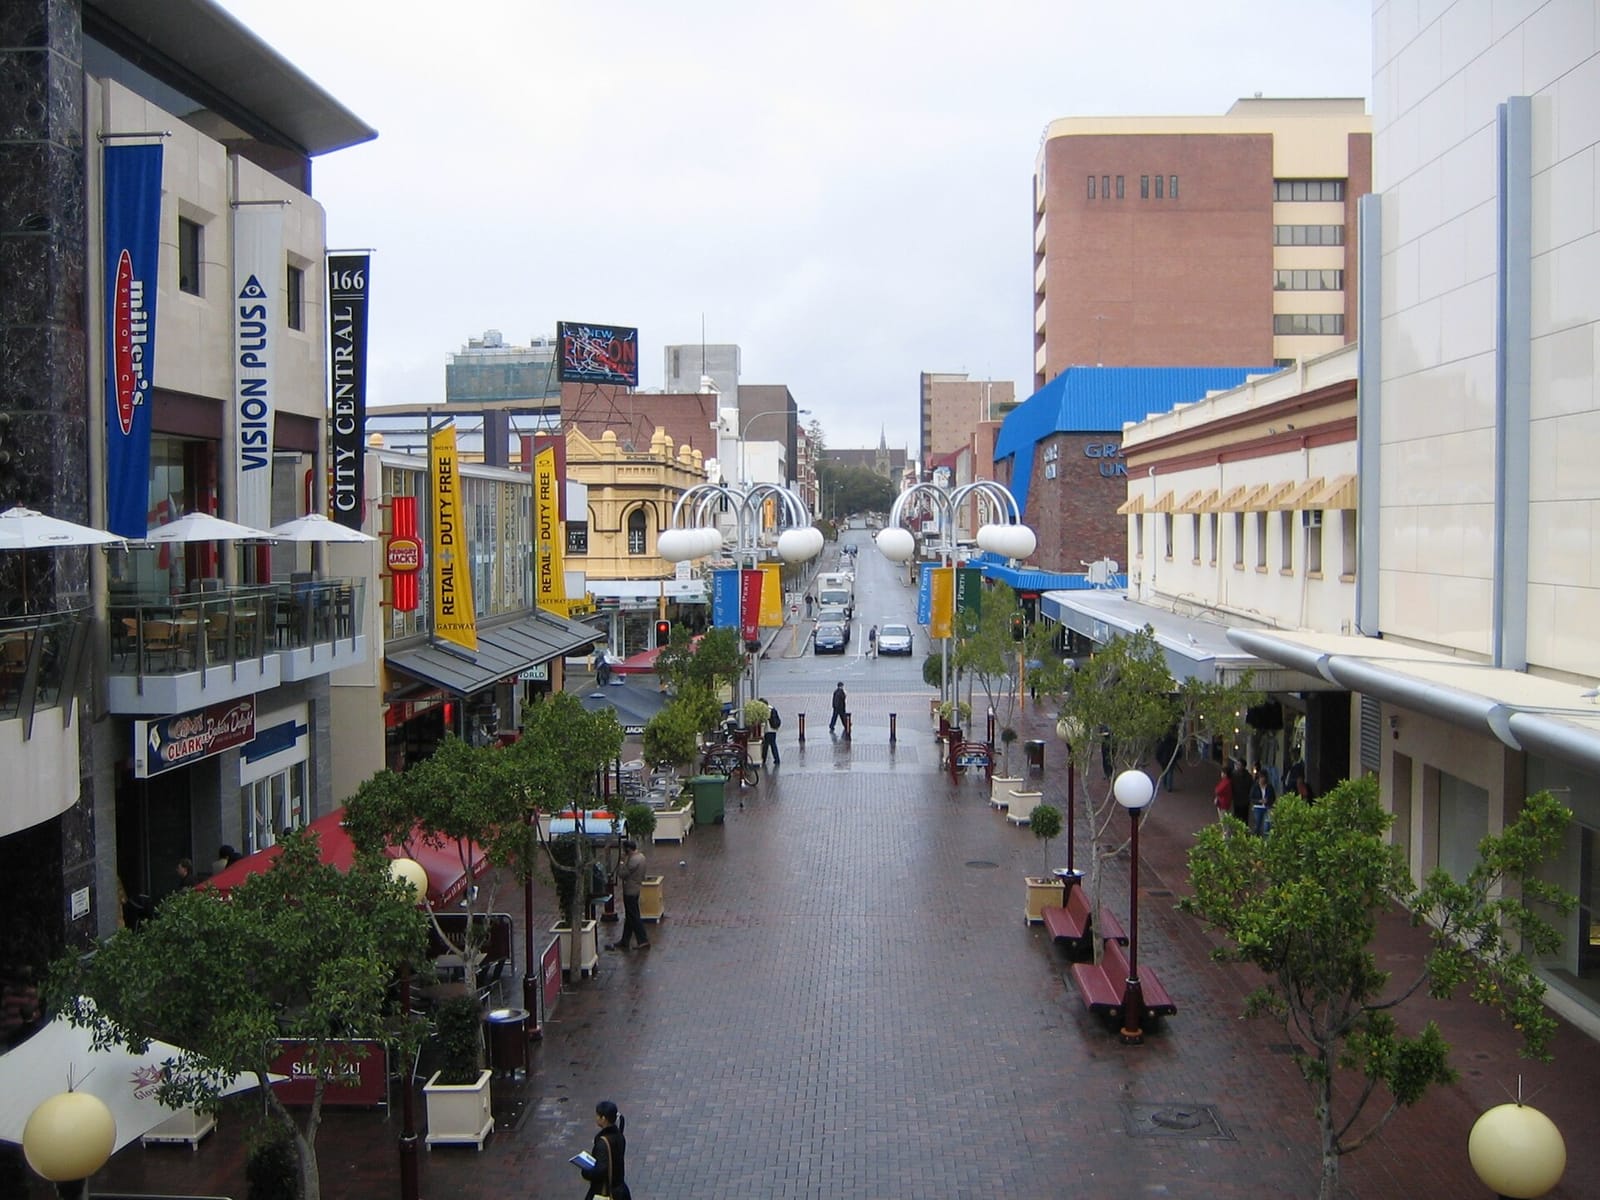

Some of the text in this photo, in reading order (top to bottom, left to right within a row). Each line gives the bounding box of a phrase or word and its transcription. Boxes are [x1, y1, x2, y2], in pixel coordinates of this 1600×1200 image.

[332, 269, 364, 291] 166
[130, 280, 148, 405] miller's
[122, 374, 130, 425] CLUB
[241, 304, 267, 472] VISION PLUS
[334, 305, 356, 512] CITY CENTRAL
[439, 457, 451, 493] FREE
[540, 472, 549, 500] FREE
[440, 498, 453, 546] DUTY
[541, 504, 551, 540] DUTY
[442, 563, 454, 616] RETAIL
[541, 553, 552, 593] RETAIL
